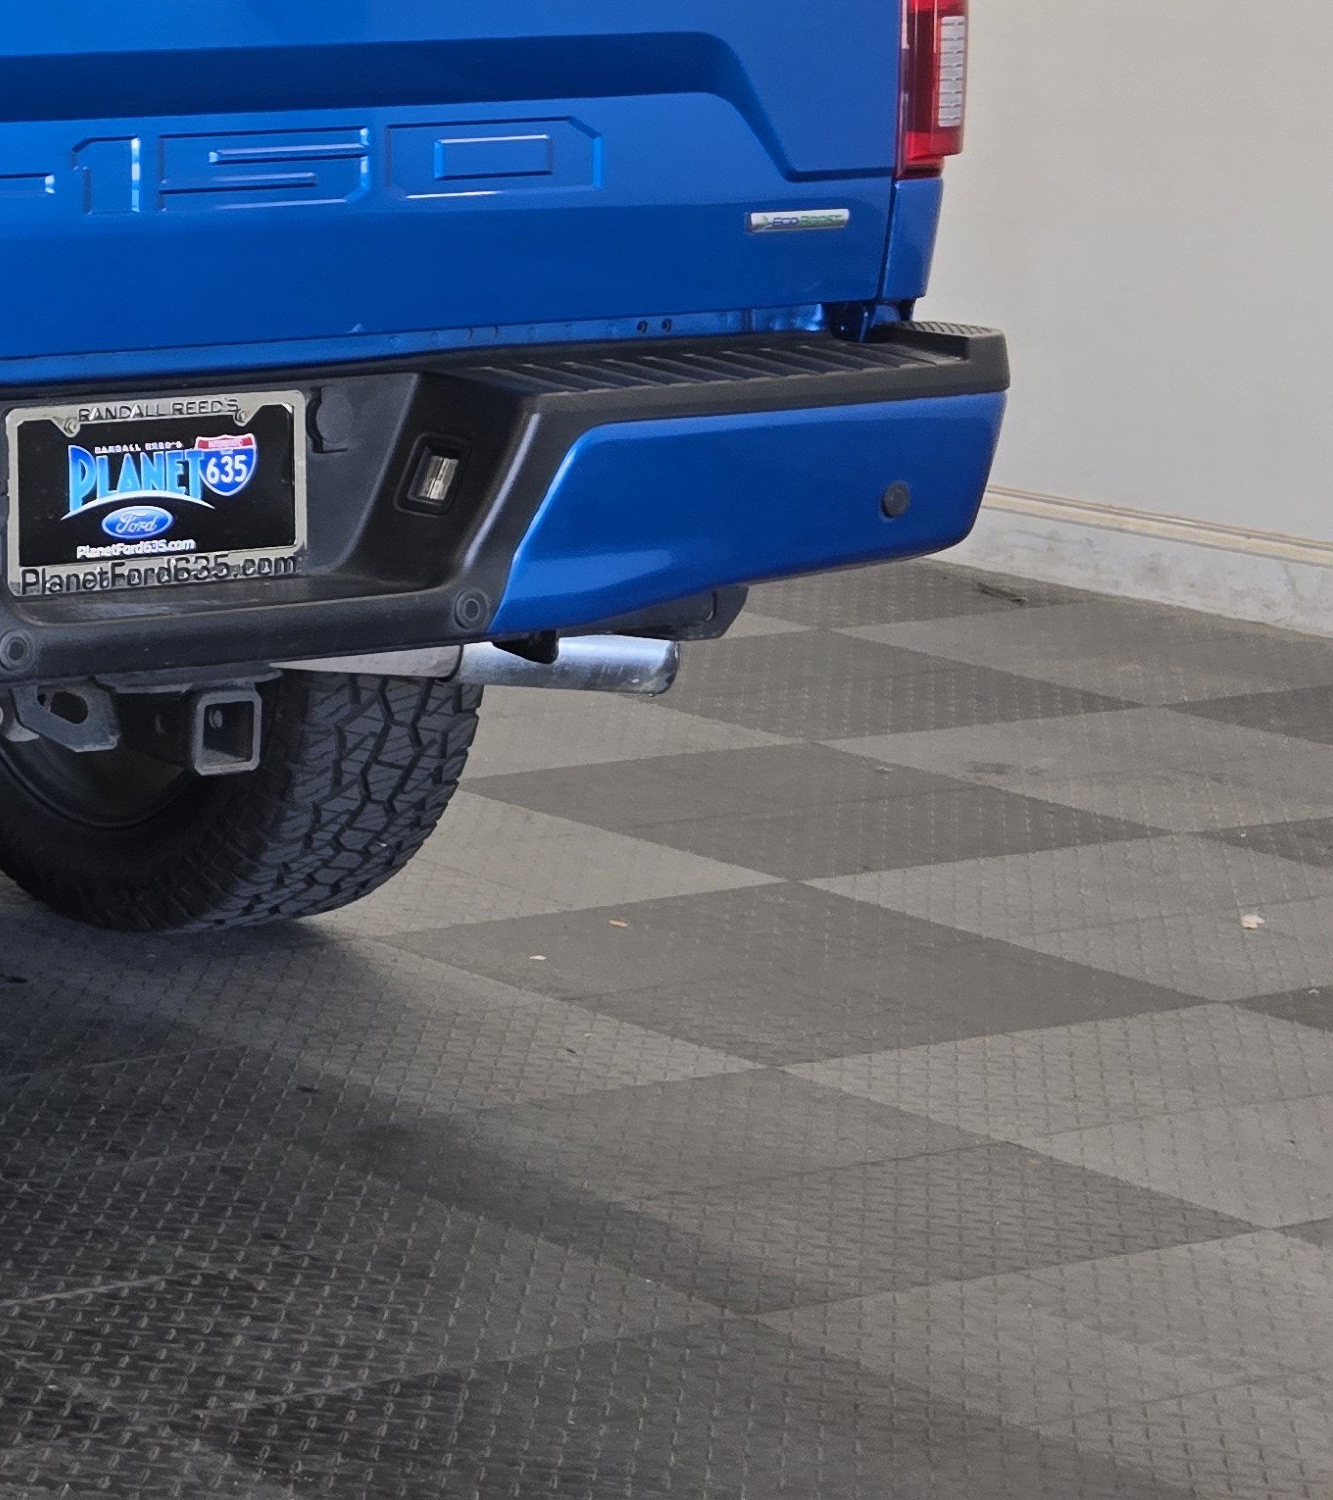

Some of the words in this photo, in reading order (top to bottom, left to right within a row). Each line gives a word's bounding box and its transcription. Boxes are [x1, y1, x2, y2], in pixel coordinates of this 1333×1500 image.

[78, 404, 165, 423] RANDALL
[171, 397, 239, 416] REED'S
[68, 445, 205, 513] PLANET
[206, 454, 248, 485] 635
[115, 511, 158, 534] Ford
[21, 553, 298, 596] PlanetFord635.com
